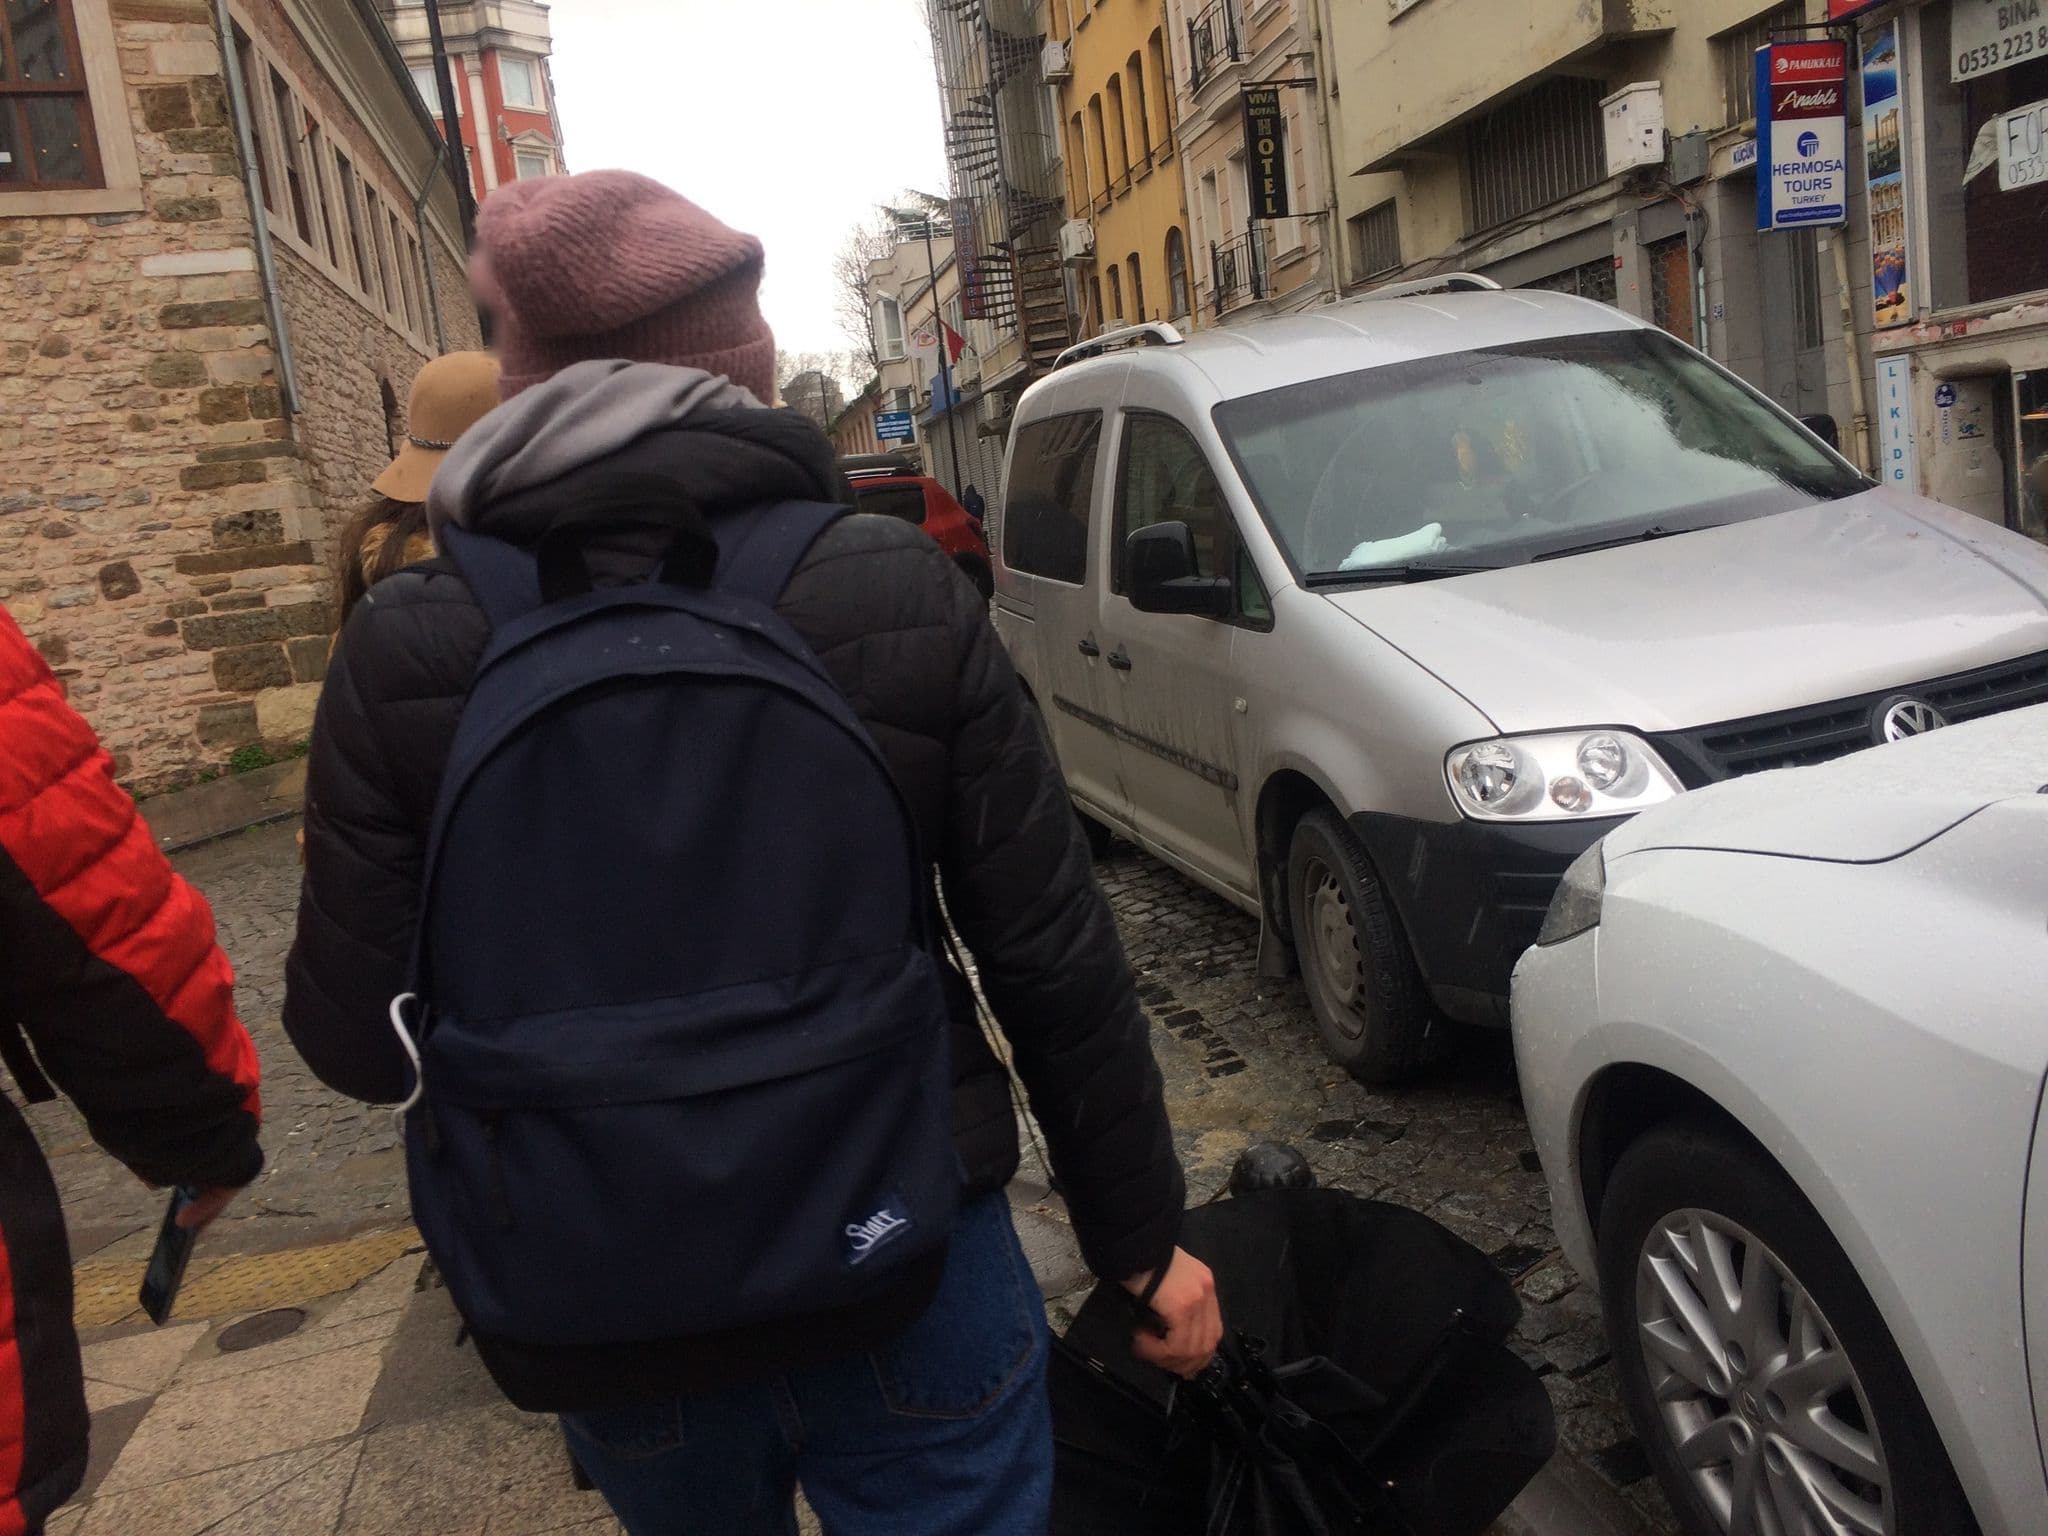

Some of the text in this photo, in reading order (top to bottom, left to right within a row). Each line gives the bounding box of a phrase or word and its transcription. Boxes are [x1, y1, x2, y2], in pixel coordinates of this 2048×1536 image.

[1958, 43, 1999, 74] 0533
[2003, 30, 2034, 60] 223
[1789, 57, 1841, 70] PAMUKKALE
[1248, 93, 1276, 104] VIVA
[1256, 118, 1277, 215] HOTEL
[1772, 160, 1844, 176] HERMOSA
[1783, 178, 1833, 193] TOURS
[1792, 194, 1826, 205] TURKEY
